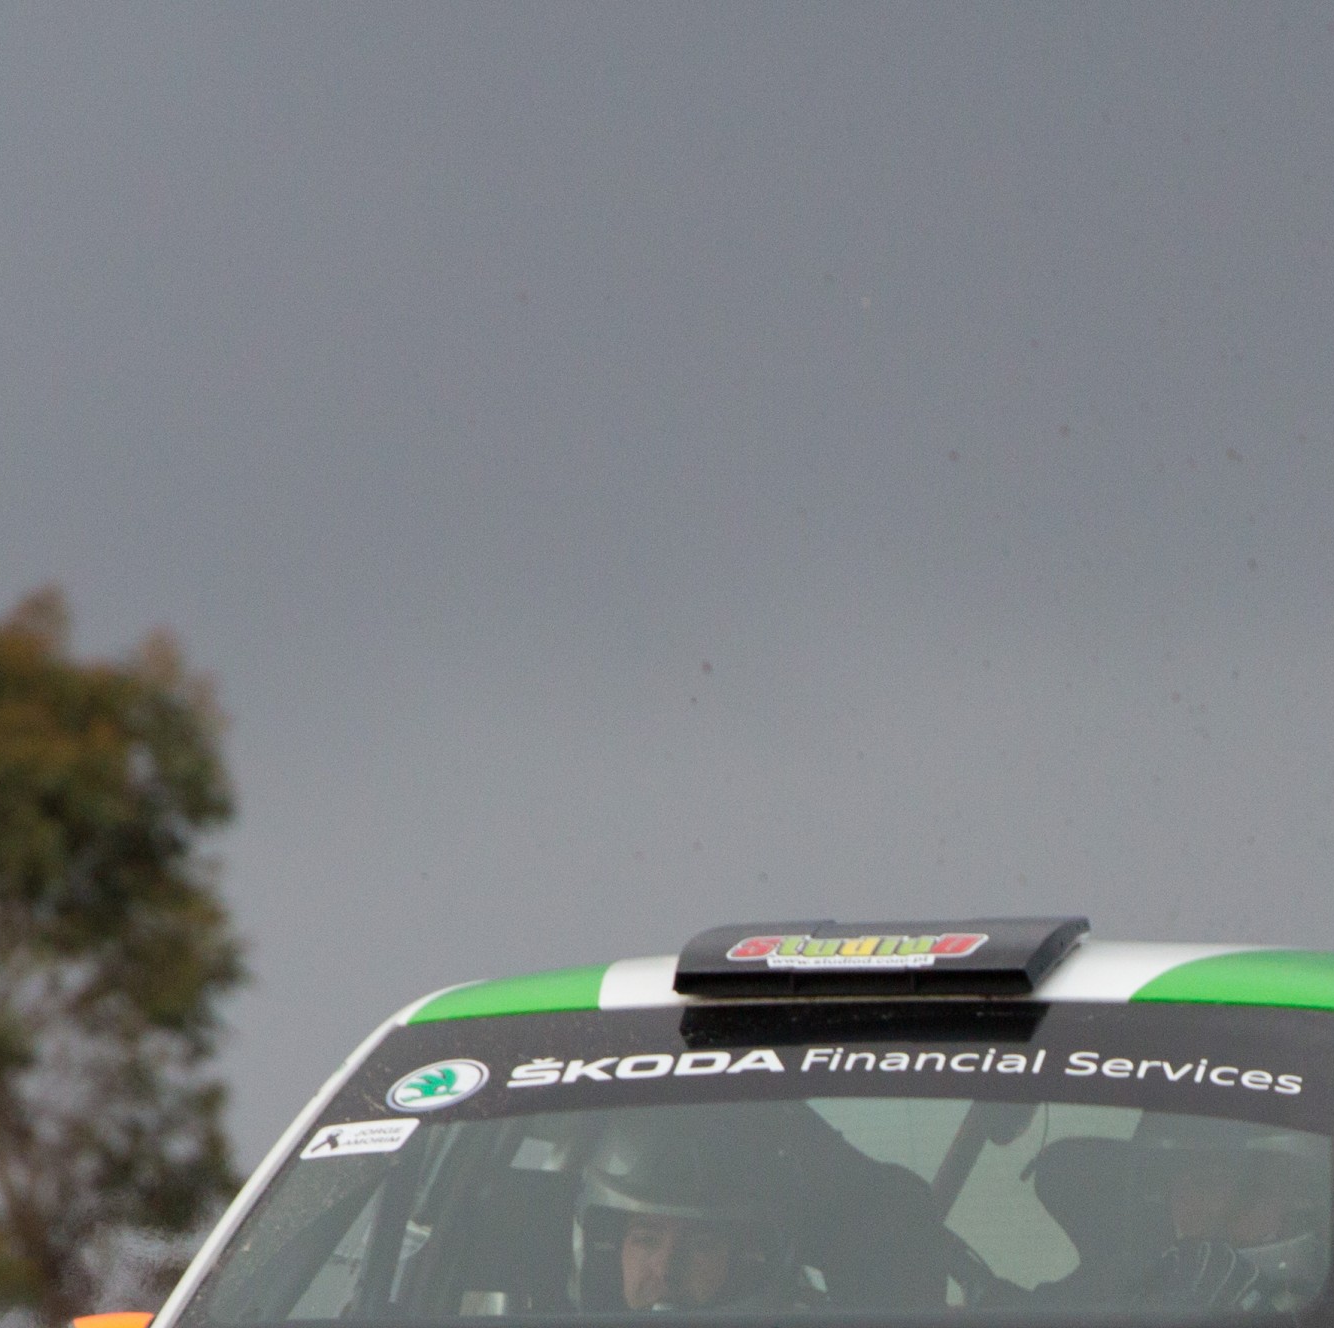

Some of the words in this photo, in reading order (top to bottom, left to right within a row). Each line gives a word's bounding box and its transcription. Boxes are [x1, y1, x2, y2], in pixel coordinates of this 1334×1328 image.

[506, 1050, 785, 1088] ŠKODA
[800, 1048, 1047, 1074] Financial
[1063, 1051, 1303, 1095] Services
